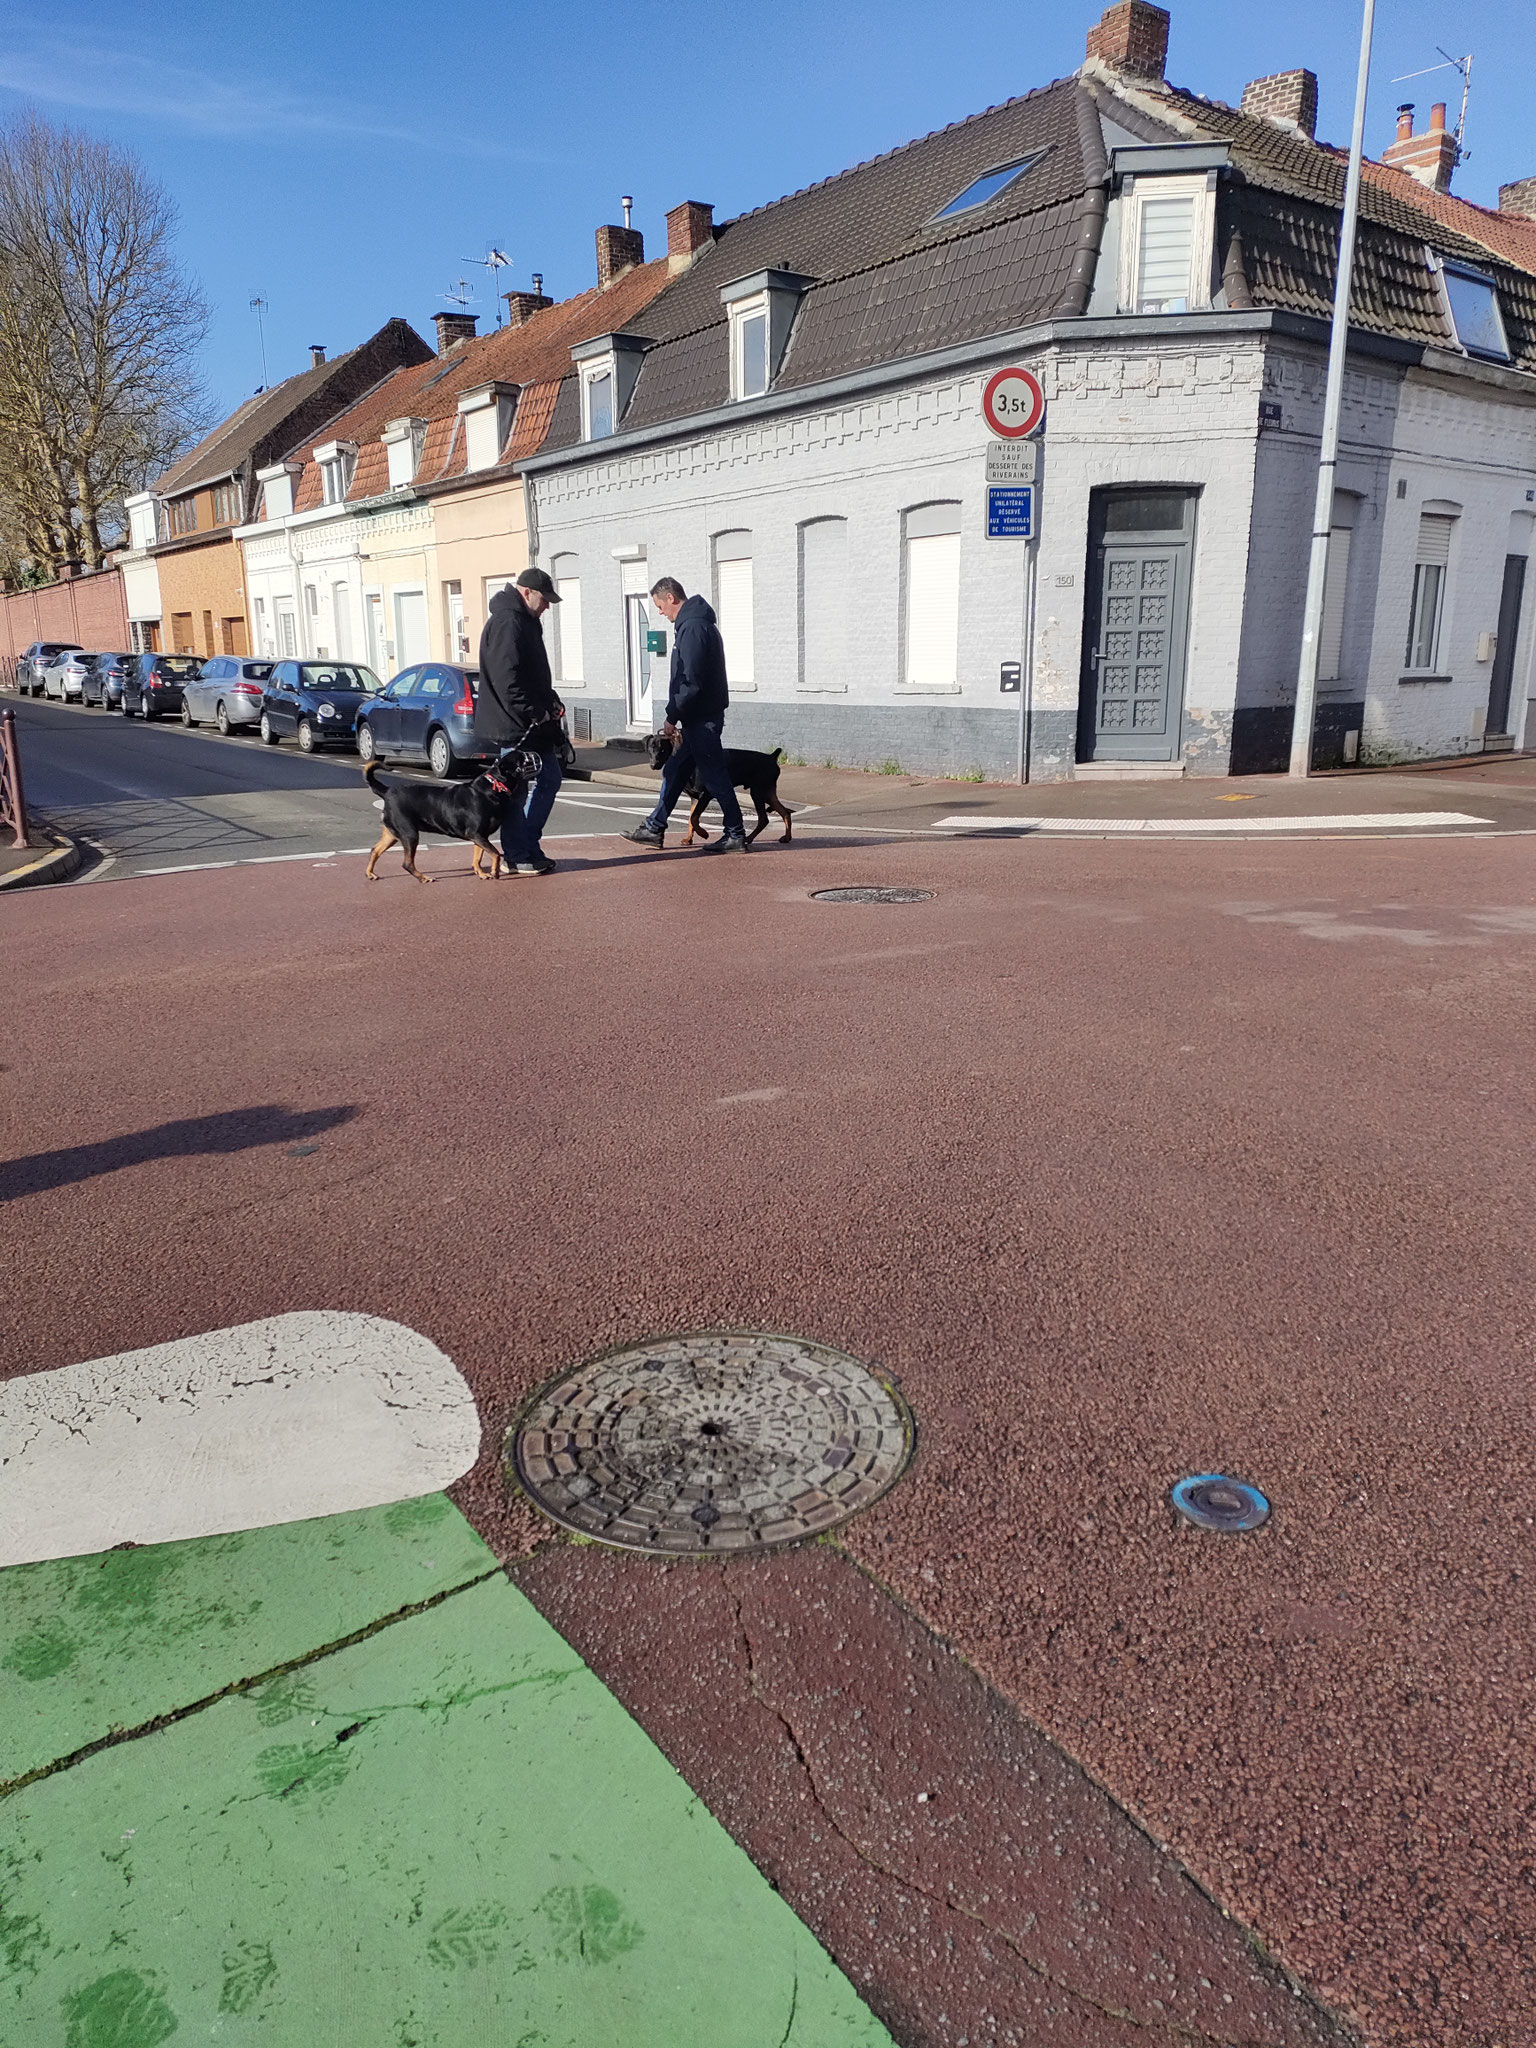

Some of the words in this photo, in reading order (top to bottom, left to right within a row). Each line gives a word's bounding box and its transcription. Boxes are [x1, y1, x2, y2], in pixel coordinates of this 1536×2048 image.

[998, 394, 1026, 415] 3,5t
[994, 444, 1028, 452] INTERDIT
[1002, 453, 1021, 461] SAUF
[988, 462, 1018, 470] DESSERTE
[1021, 462, 1033, 470] DES
[992, 471, 1029, 479] RIVERAINS
[994, 499, 1025, 507] UNILATÉRAL
[1003, 516, 1030, 524] VÉHICULES
[1002, 525, 1027, 533] TOURISME
[1056, 576, 1072, 585] 150
